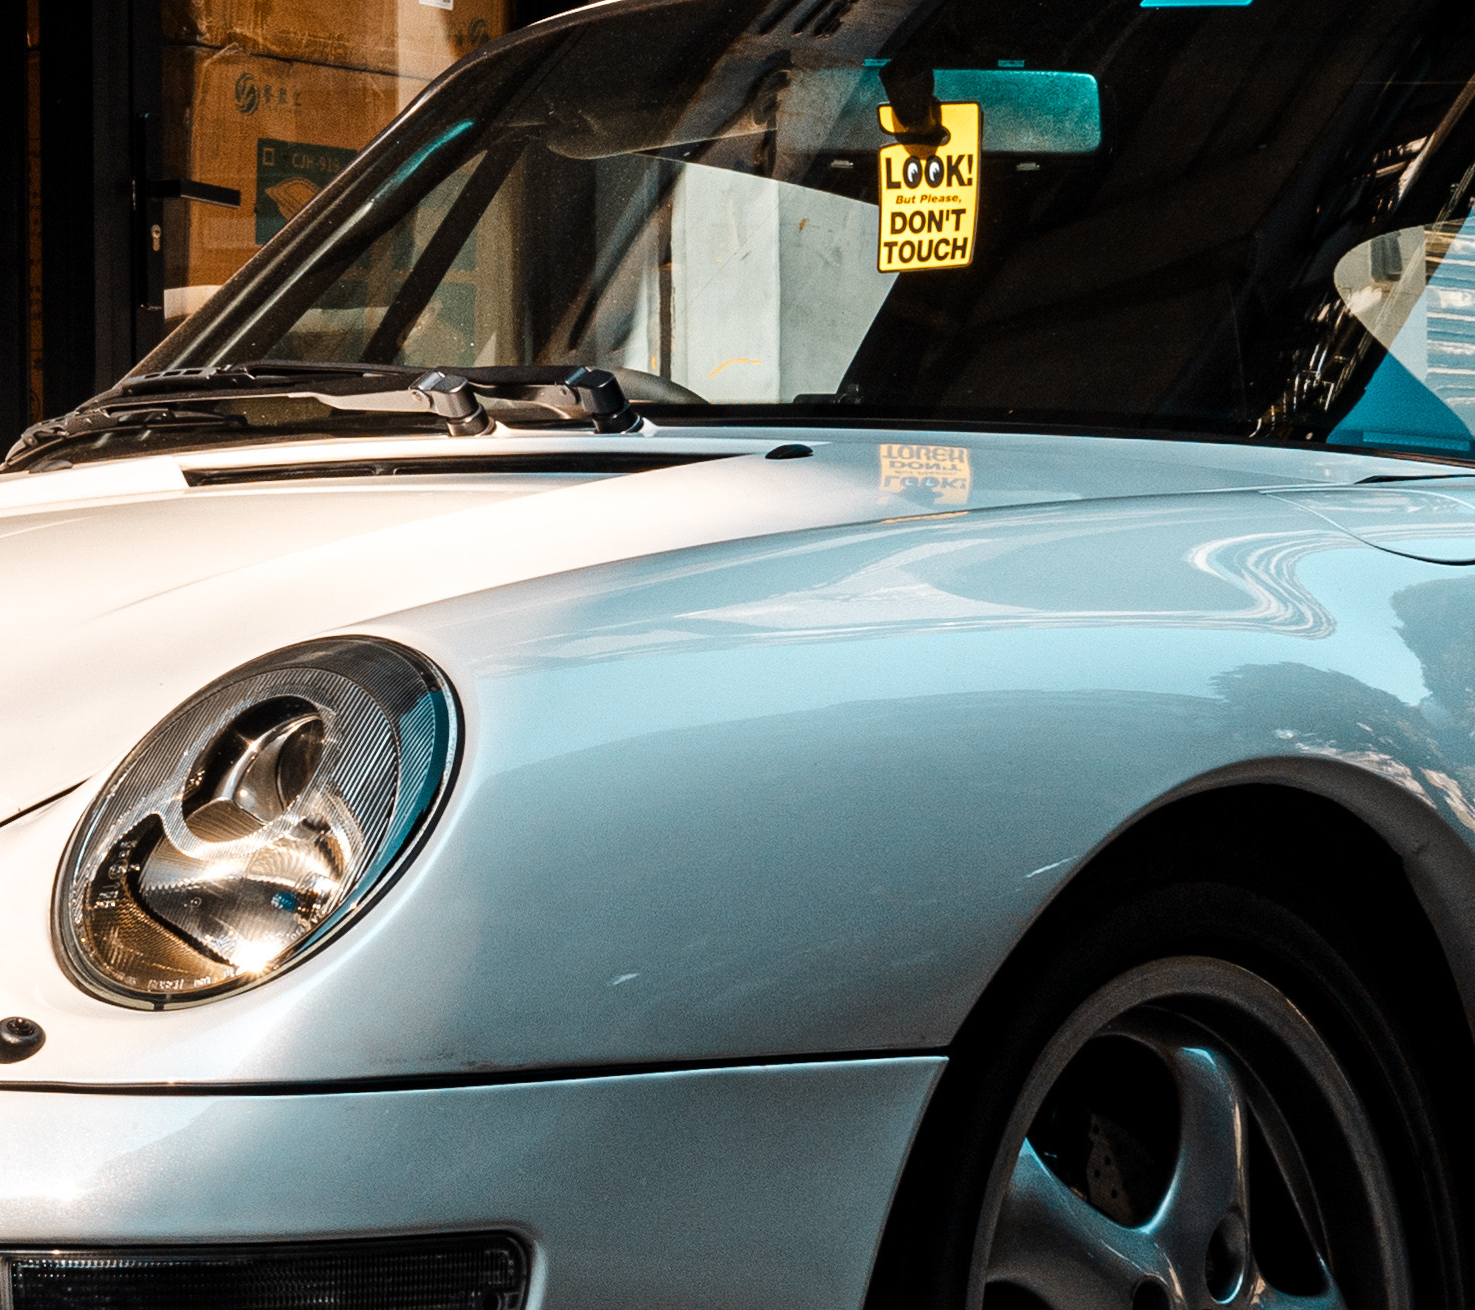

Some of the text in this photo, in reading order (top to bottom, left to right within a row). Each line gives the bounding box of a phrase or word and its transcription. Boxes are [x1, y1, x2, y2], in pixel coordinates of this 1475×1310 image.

[884, 154, 973, 190] LOOK!
[895, 193, 963, 205] But Please,
[890, 208, 967, 235] DON'T
[883, 237, 969, 265] TOUCH
